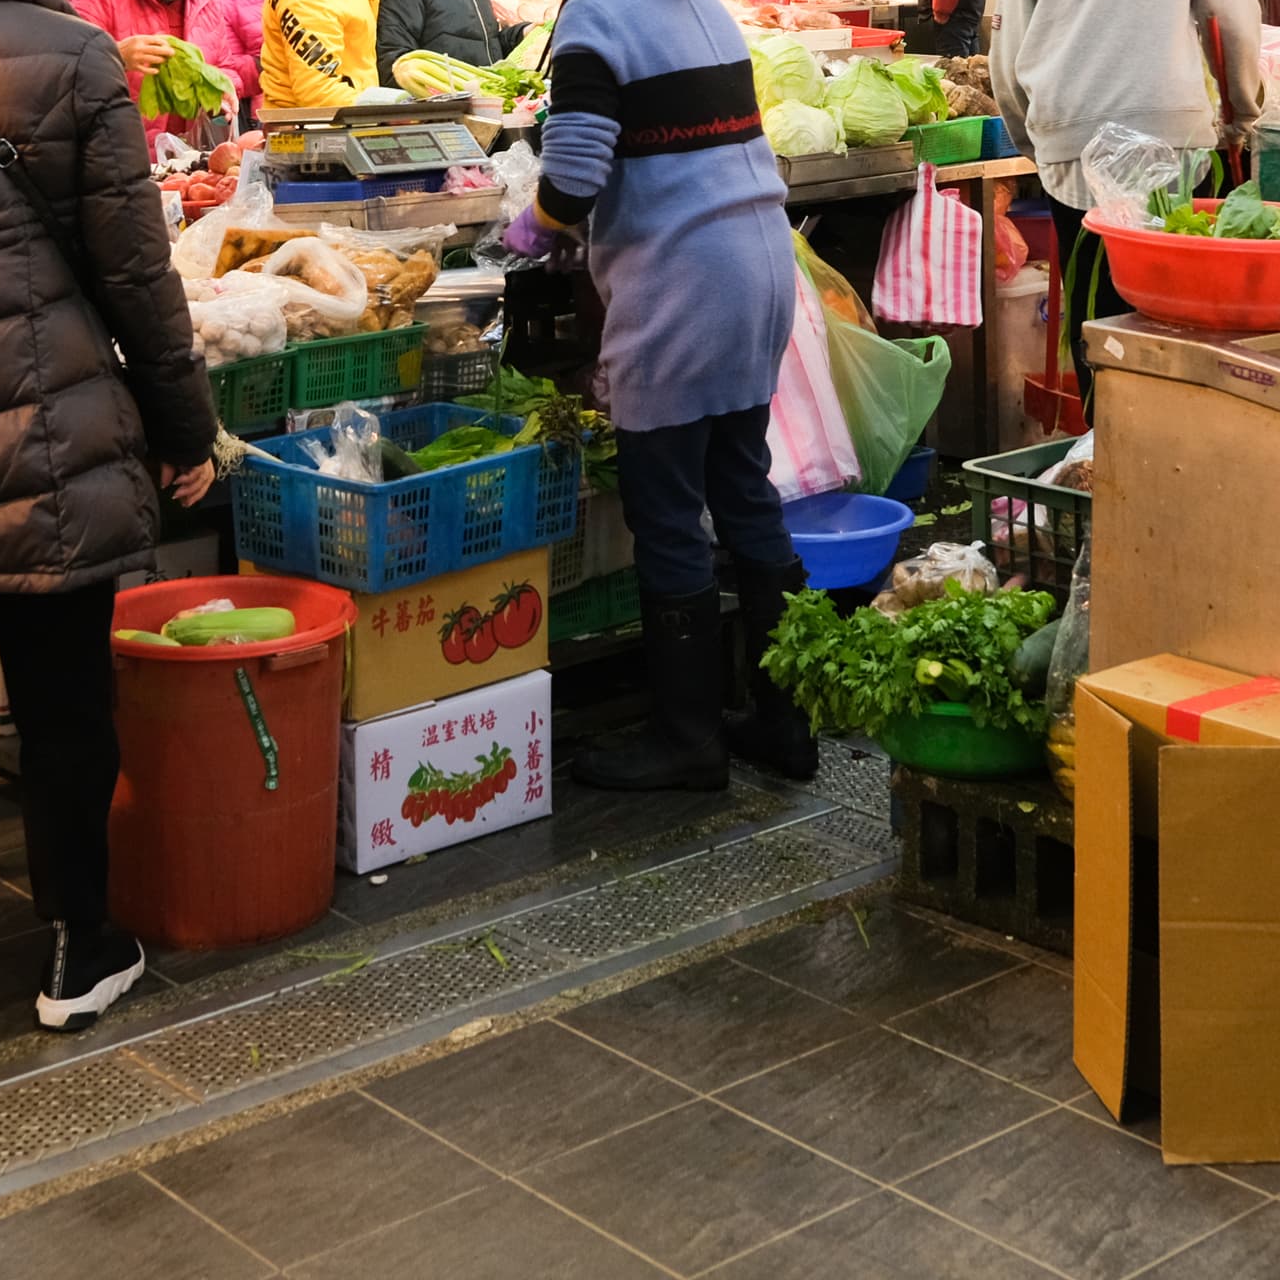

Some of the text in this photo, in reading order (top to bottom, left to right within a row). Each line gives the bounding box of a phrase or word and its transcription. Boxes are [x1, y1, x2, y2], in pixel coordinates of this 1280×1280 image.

[371, 594, 436, 639] 牛蕃茄
[523, 710, 544, 805] 小蕃茄
